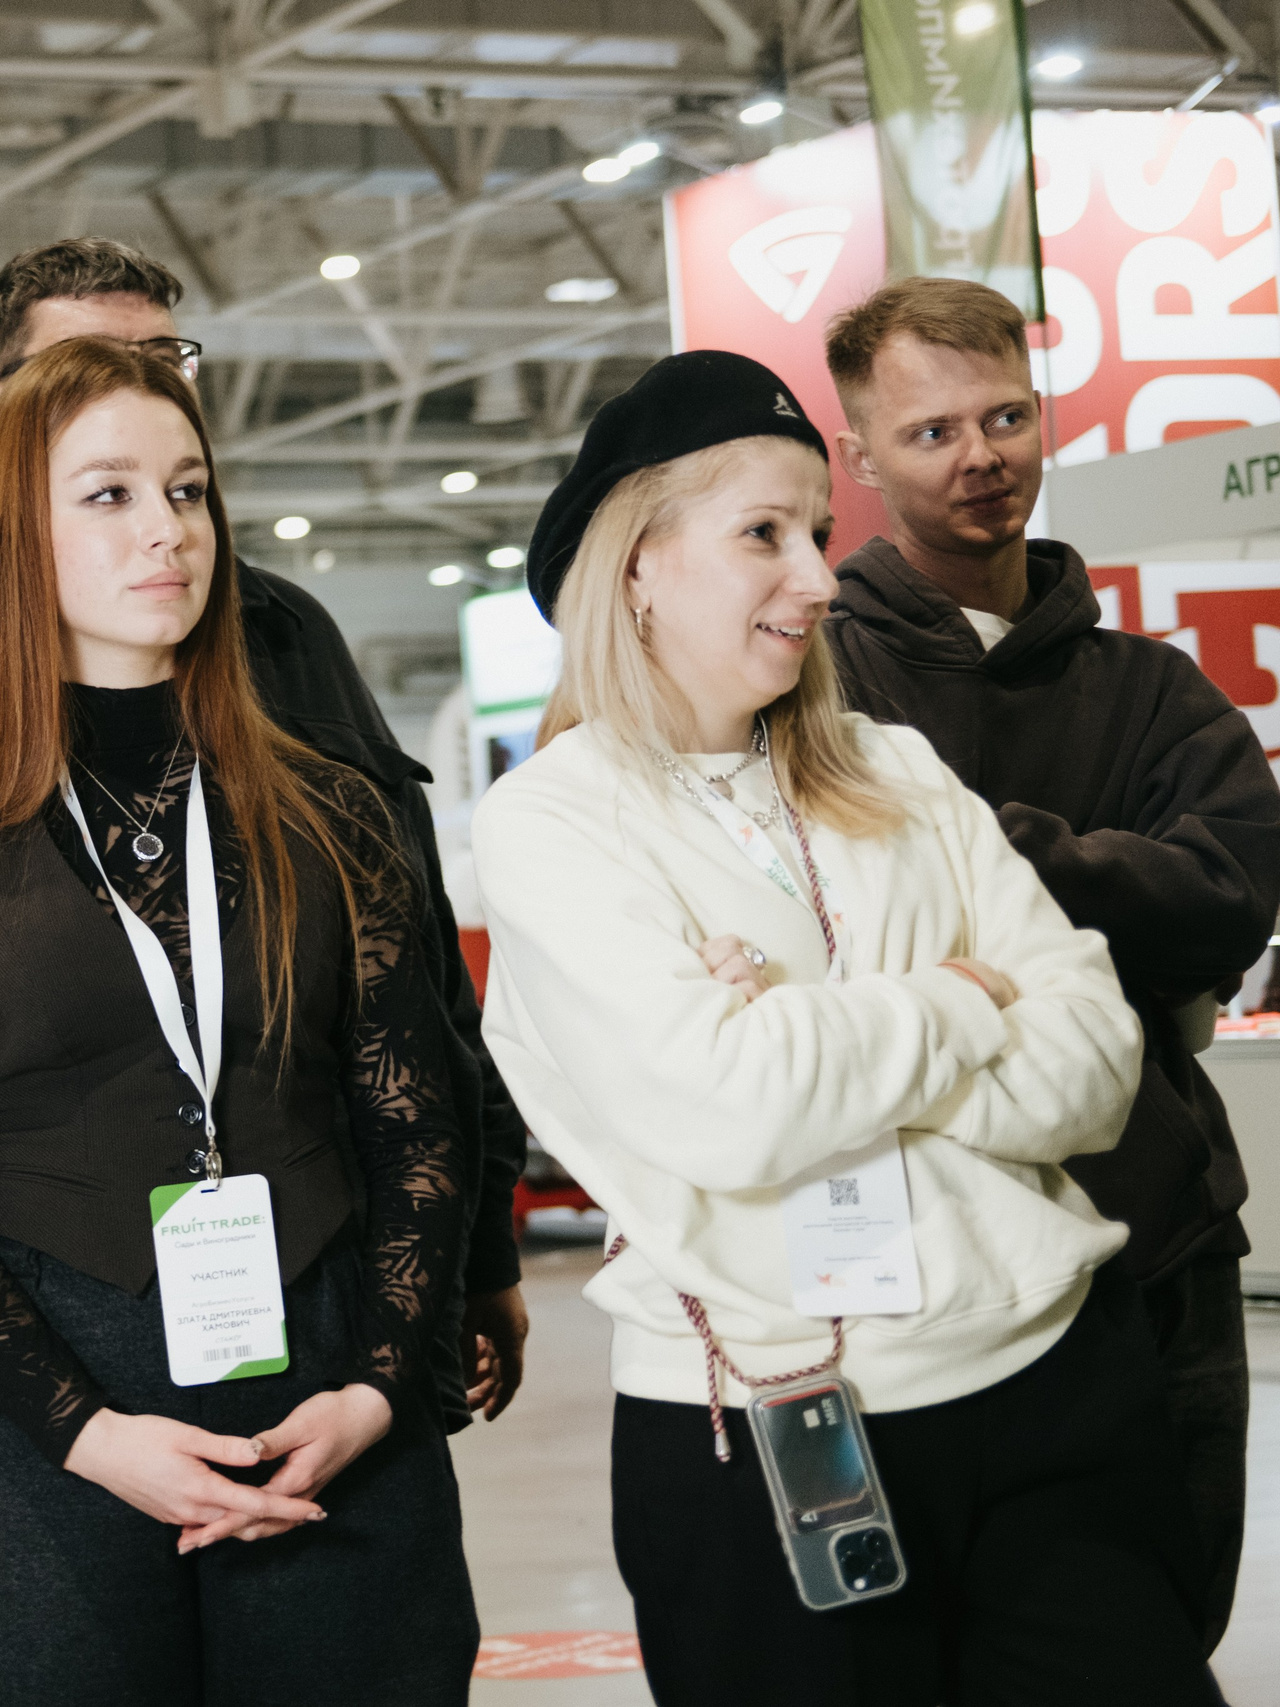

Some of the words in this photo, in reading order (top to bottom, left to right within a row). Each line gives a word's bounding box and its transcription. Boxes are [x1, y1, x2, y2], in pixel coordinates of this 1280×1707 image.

[191, 1267, 248, 1281] УЧАСТНИК
[176, 1314, 207, 1325] ЗЛАТА
[209, 1306, 273, 1322] ДМИТРИЕВНА
[202, 1319, 251, 1332] ХАМОВИЧ
